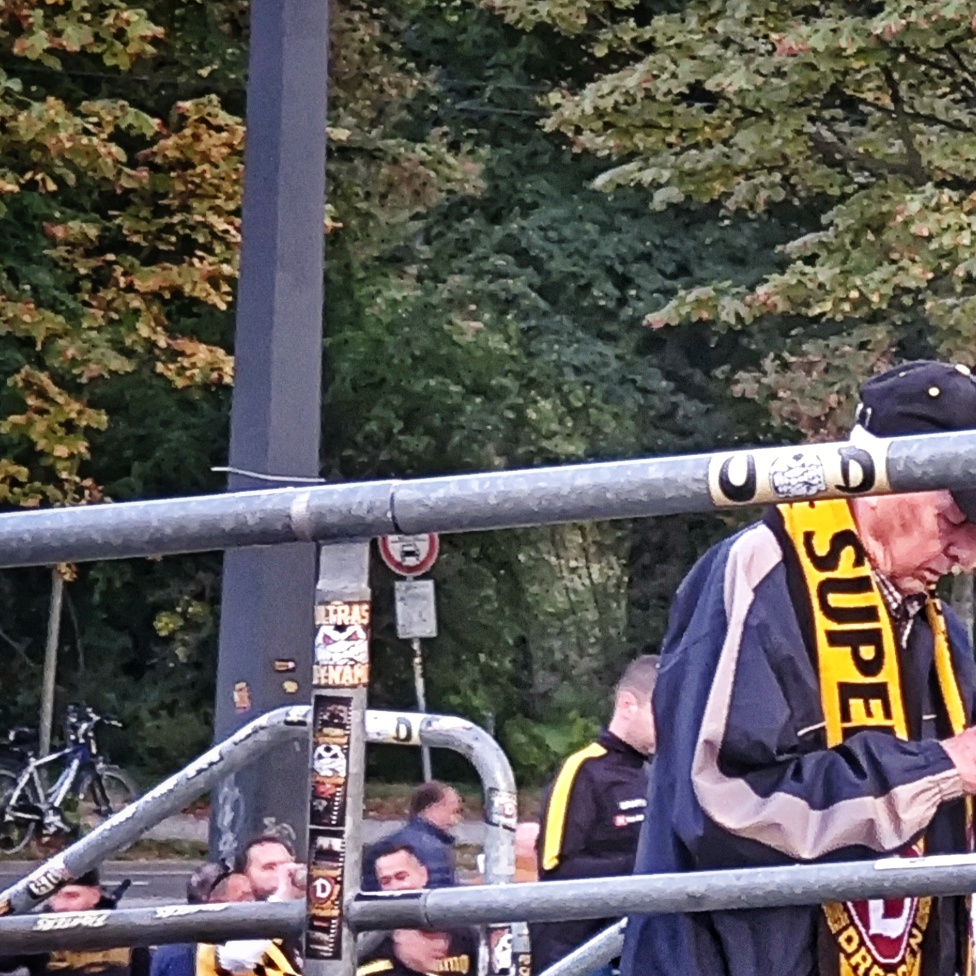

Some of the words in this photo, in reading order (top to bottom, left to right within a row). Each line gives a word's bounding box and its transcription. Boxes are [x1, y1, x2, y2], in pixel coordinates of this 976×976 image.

[718, 454, 757, 502] U
[835, 445, 876, 493] D
[803, 528, 897, 738] SUPE
